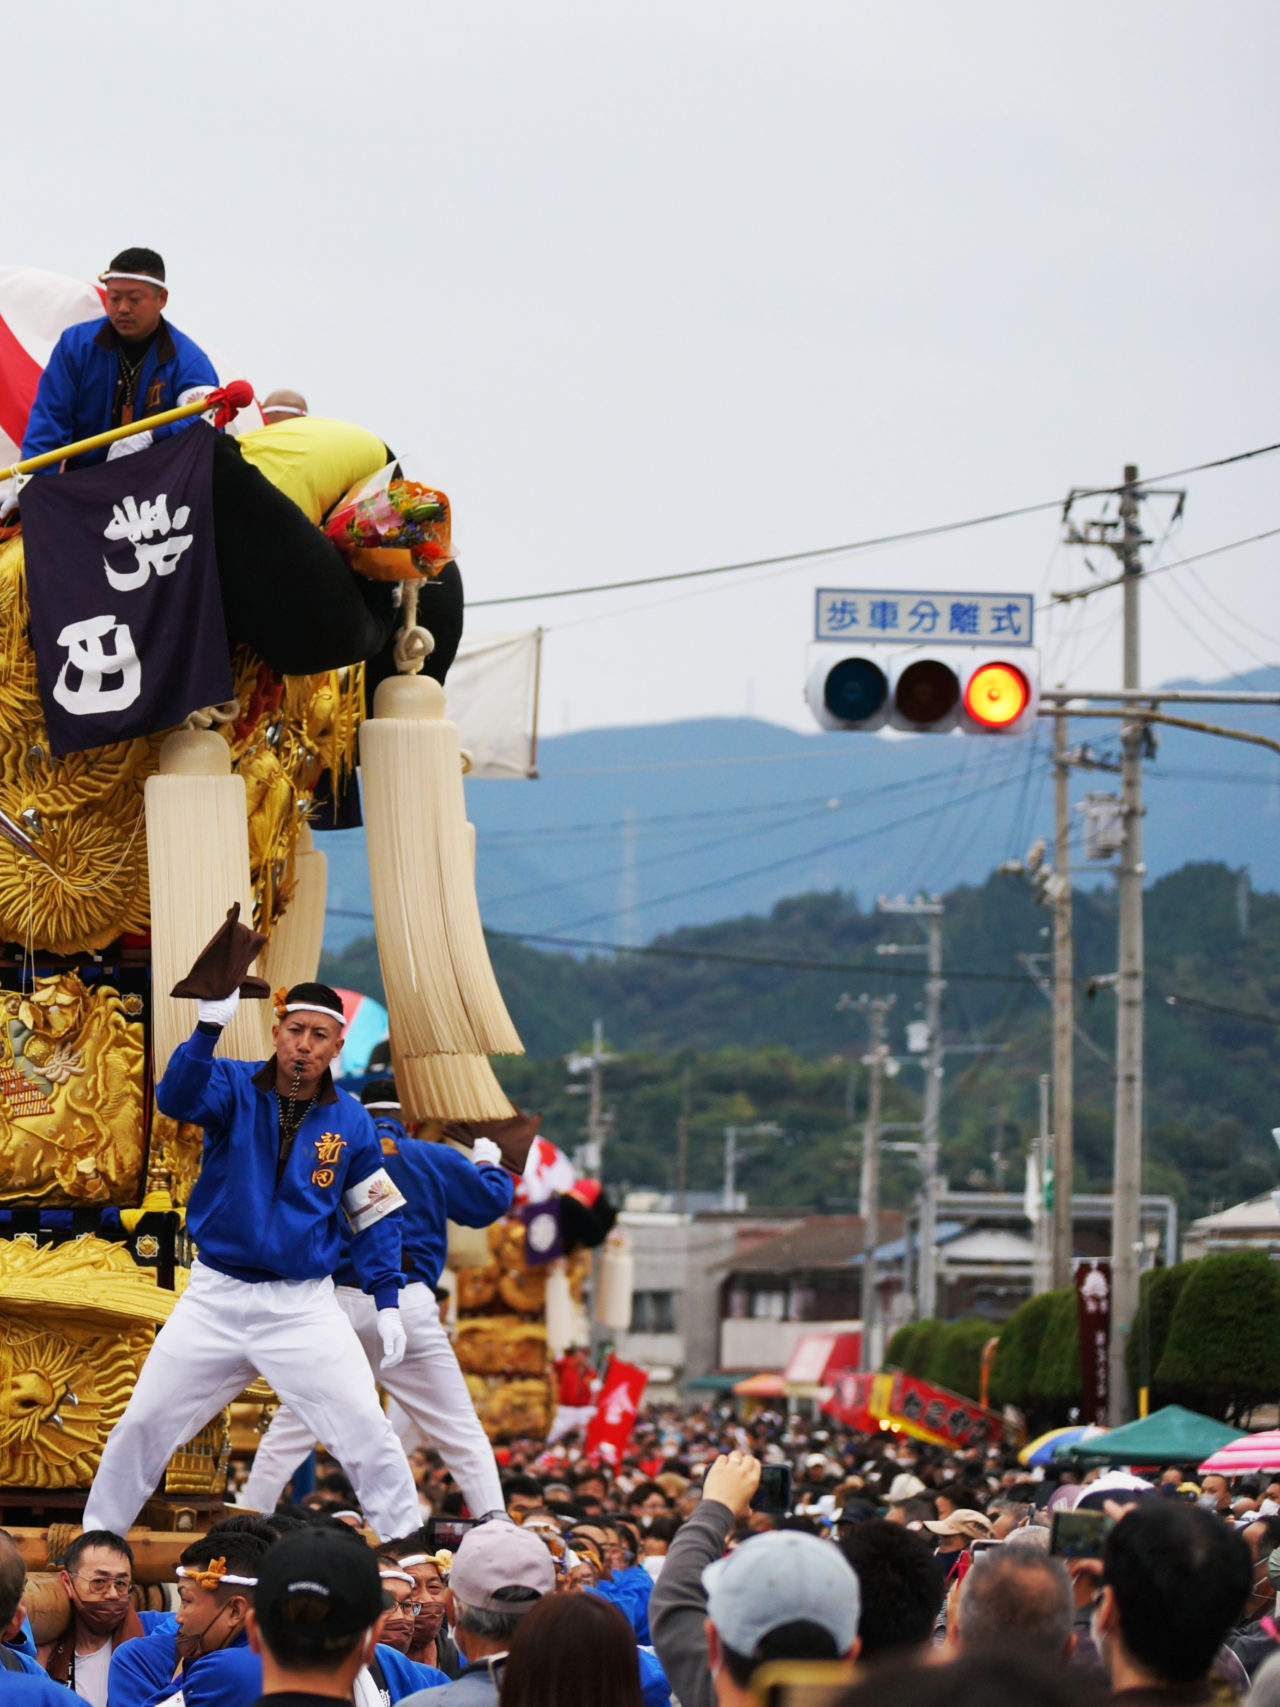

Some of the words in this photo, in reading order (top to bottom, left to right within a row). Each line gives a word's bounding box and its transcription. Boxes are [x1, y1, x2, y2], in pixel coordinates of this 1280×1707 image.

[826, 599, 1023, 636] 歩車分離式
[312, 1132, 348, 1189] 新田
